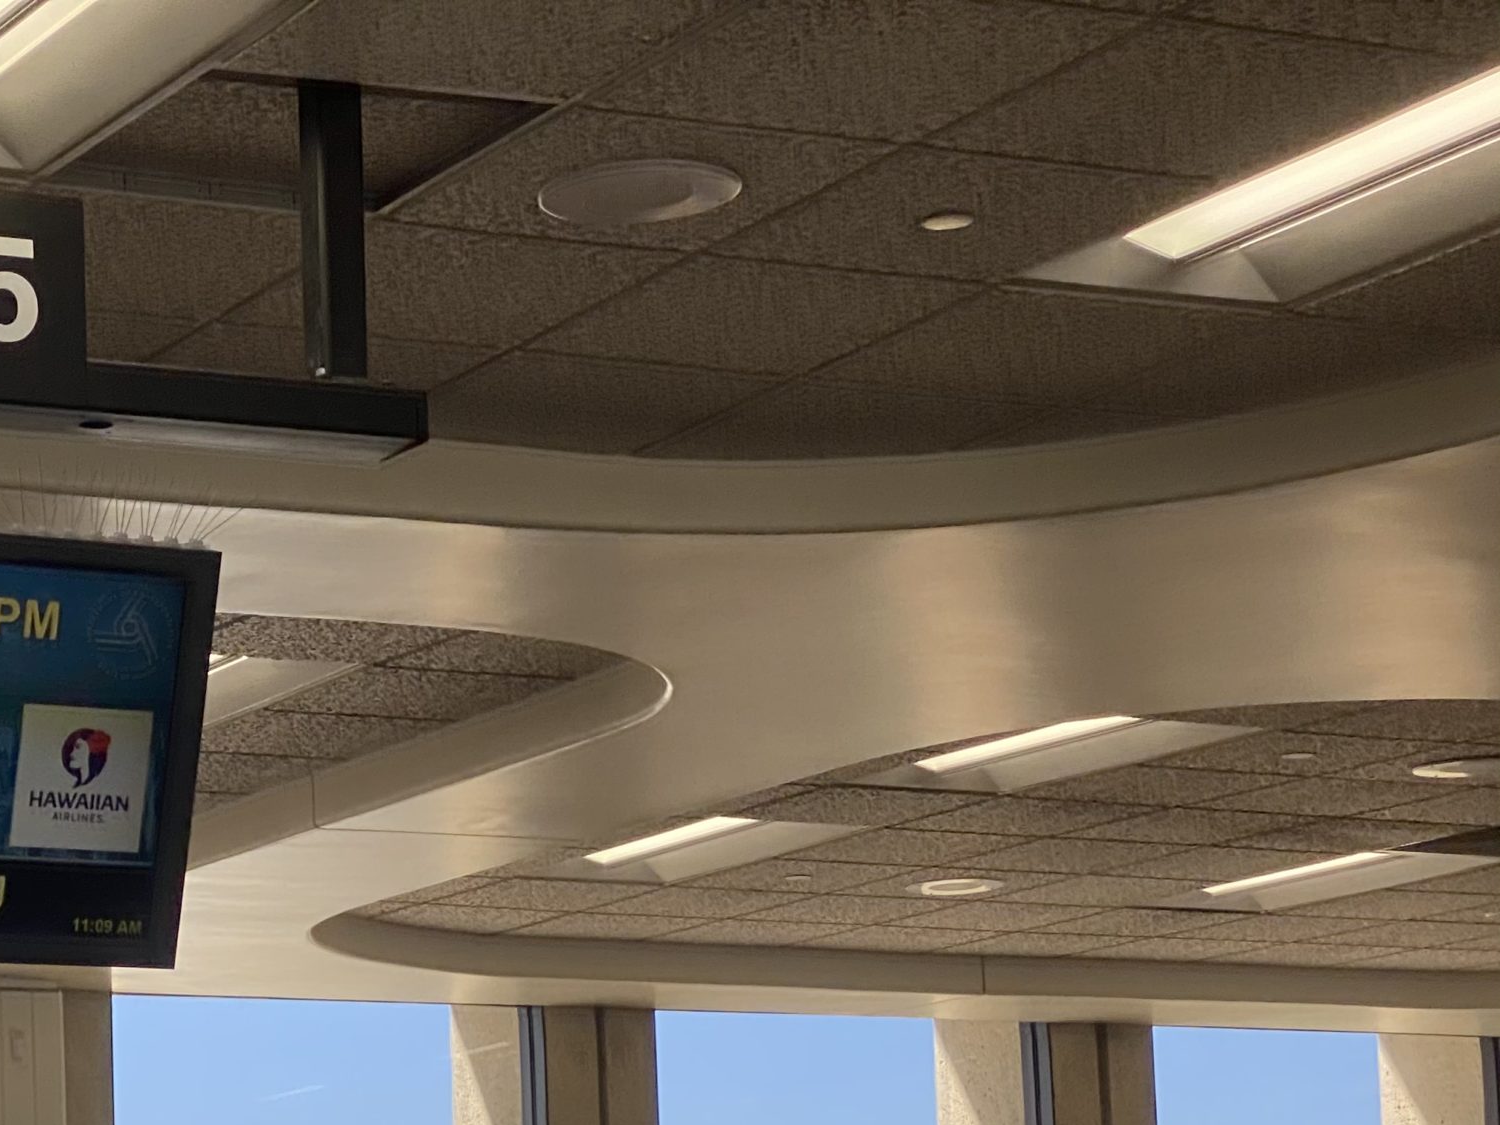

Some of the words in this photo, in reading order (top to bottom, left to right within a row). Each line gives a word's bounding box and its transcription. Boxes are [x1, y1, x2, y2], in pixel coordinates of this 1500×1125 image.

[29, 790, 129, 812] HAWAIIAN
[72, 916, 114, 935] 11:09
[117, 919, 142, 936] AM
